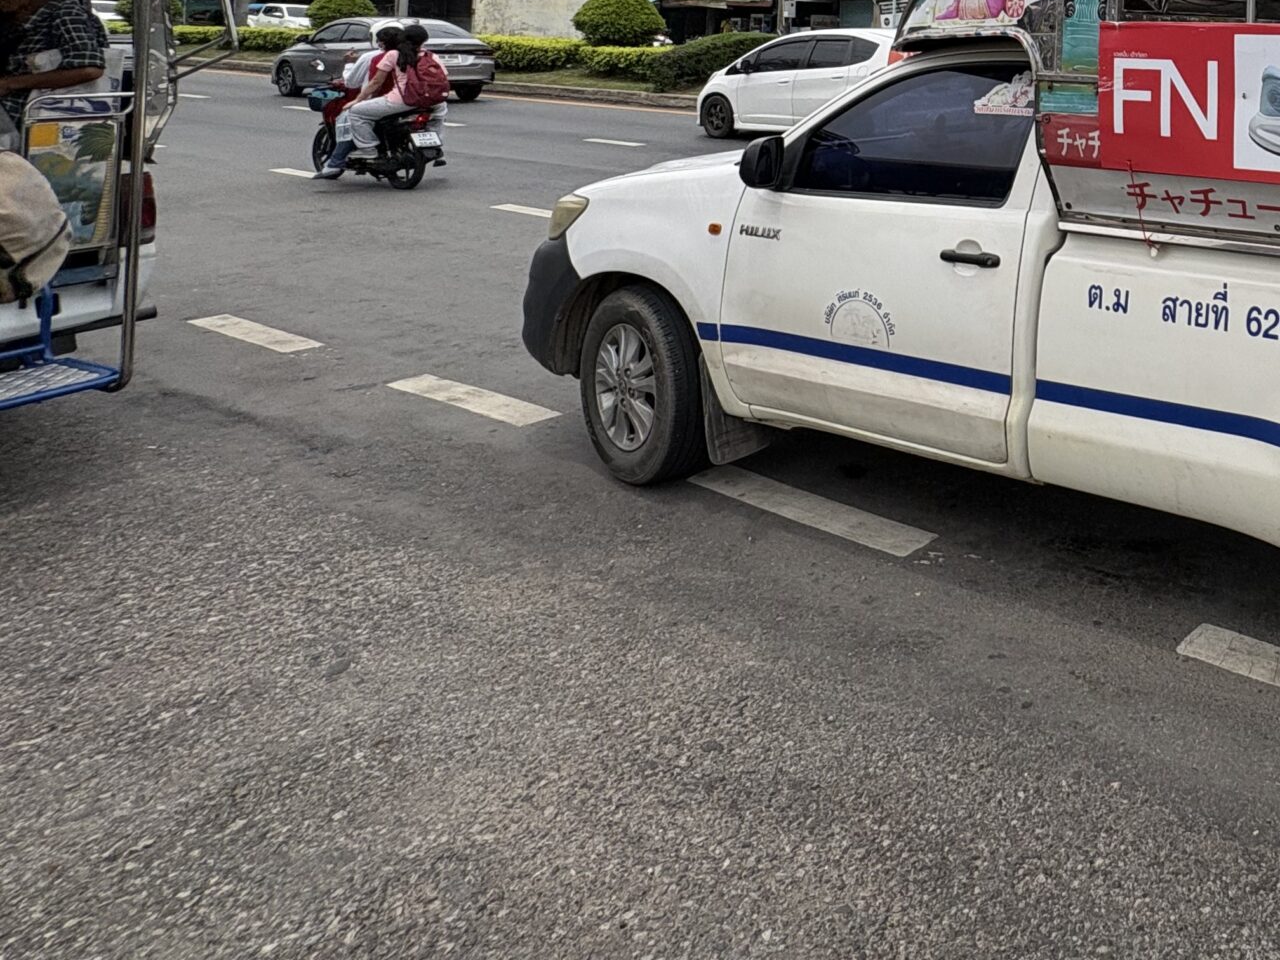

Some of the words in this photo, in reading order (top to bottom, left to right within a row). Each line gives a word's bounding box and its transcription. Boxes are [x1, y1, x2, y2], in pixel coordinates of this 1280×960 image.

[1113, 57, 1219, 141] FN
[740, 224, 782, 241] HILUX
[862, 292, 882, 310] 2536
[1088, 284, 1130, 314] ต.ม
[1161, 283, 1229, 332] สายที่
